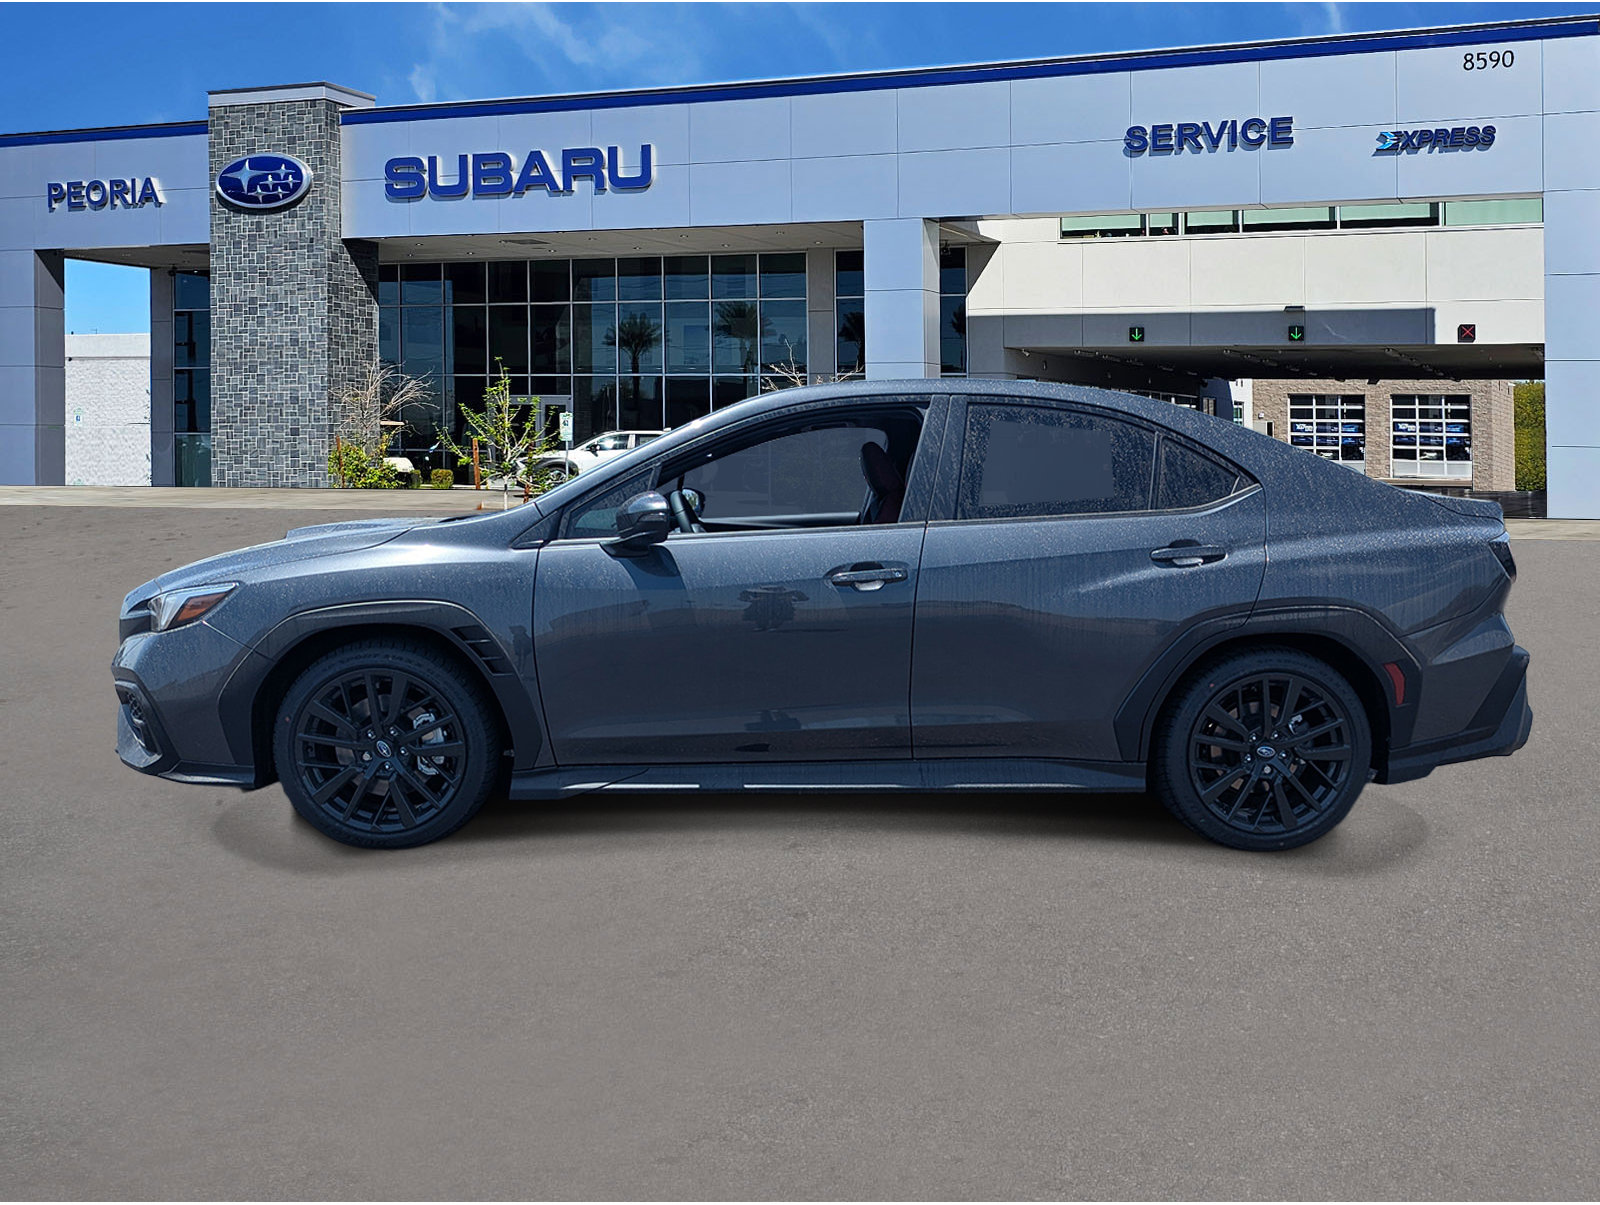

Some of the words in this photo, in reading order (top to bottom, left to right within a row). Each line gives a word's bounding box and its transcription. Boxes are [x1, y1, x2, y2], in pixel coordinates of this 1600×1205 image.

[1463, 50, 1515, 71] 8590
[1124, 116, 1295, 153] SERVICE
[1376, 125, 1497, 151] EXPRESS
[385, 144, 653, 201] SUBARU
[47, 177, 162, 211] PEORIA
